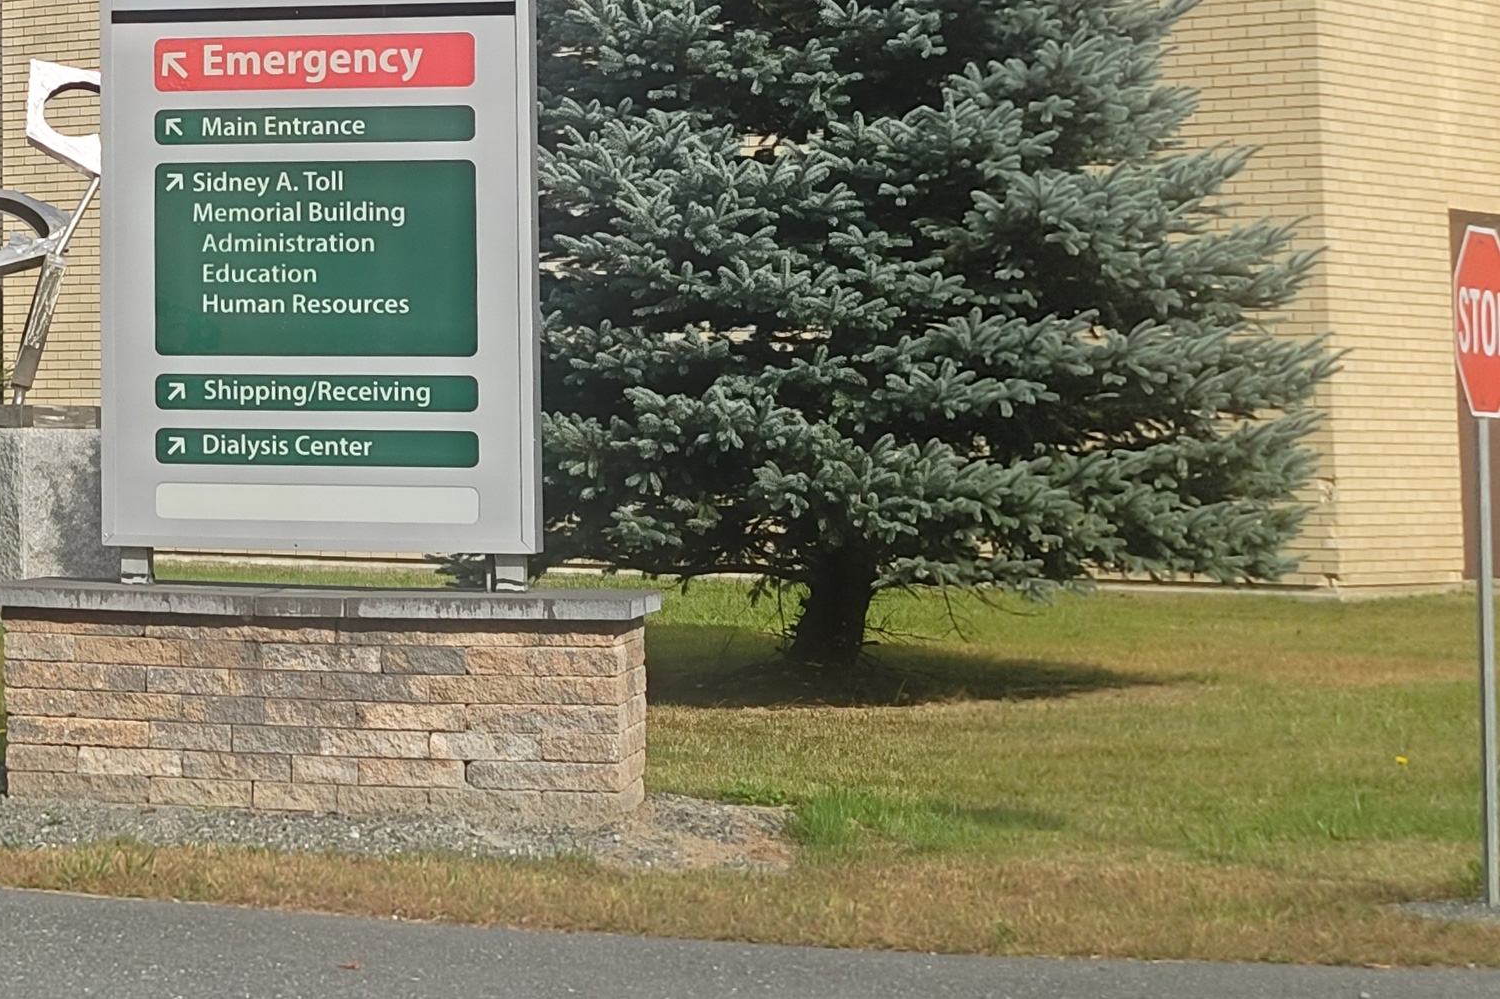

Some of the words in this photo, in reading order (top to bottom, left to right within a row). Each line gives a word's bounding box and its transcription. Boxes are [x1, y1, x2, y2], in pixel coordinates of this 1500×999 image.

[203, 44, 422, 83] Emergency
[202, 117, 257, 136] Main
[264, 116, 366, 136] Entrance
[192, 172, 270, 197] Sidney
[276, 172, 299, 191] A.
[303, 170, 344, 191] Toll
[193, 202, 301, 222] Memorial
[308, 201, 406, 227] Building
[202, 233, 375, 253] Administration
[202, 263, 317, 283] Education
[202, 294, 285, 313] Human
[292, 294, 410, 314] Resources
[1458, 286, 1500, 357] STO
[204, 379, 431, 407] Shipping/Receiving
[203, 434, 289, 460] Dialysis
[294, 435, 373, 456] Center
